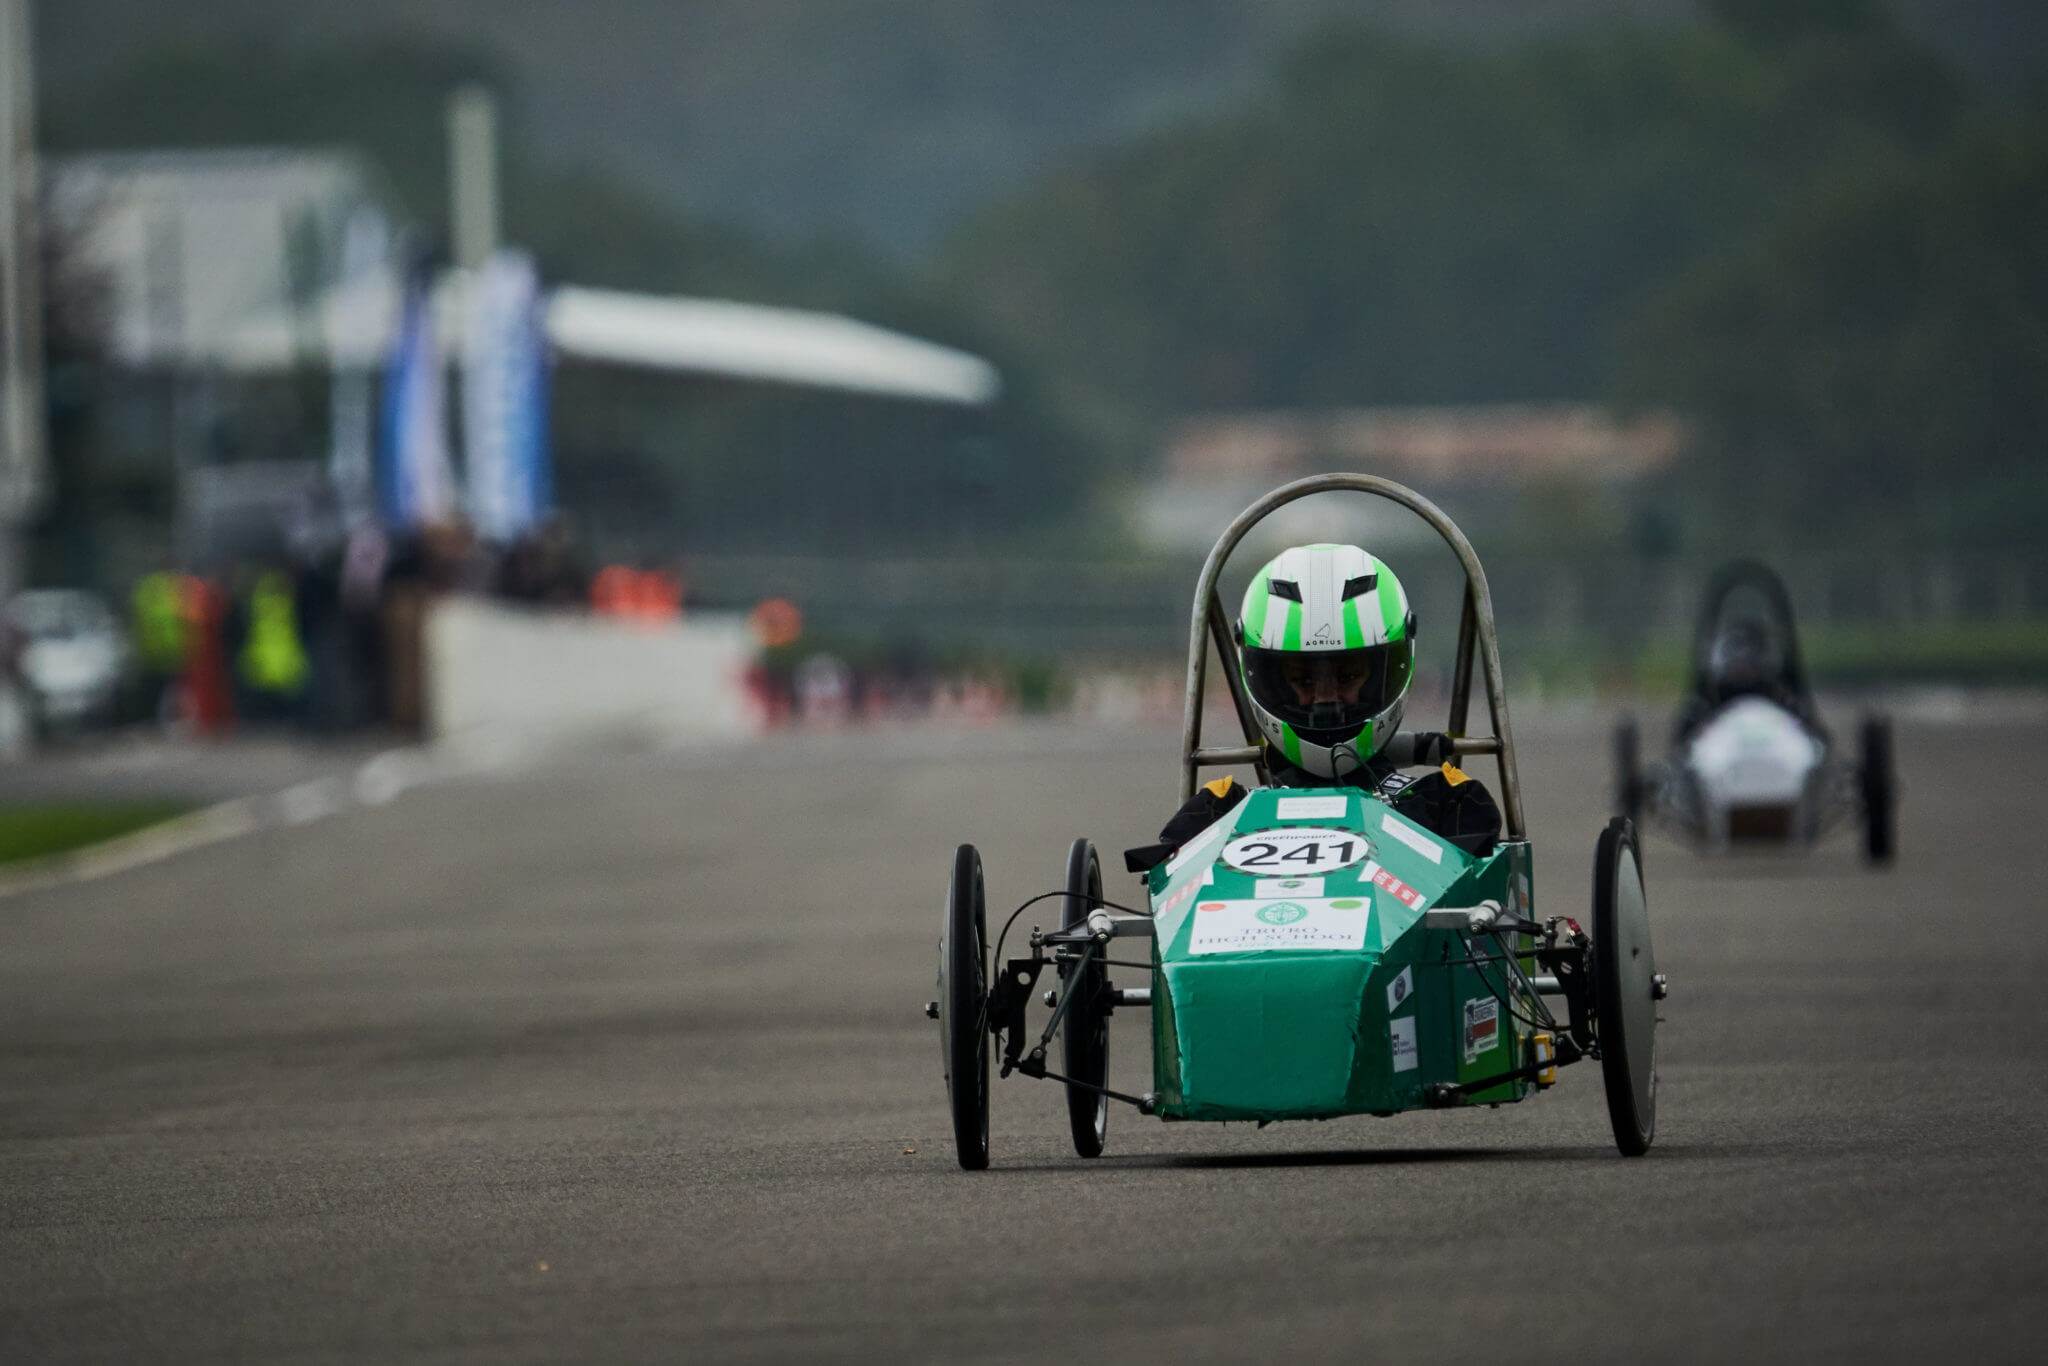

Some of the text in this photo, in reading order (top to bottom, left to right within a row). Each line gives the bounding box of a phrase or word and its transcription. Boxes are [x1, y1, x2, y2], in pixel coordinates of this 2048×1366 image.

[1240, 841, 1354, 866] 241
[1241, 927, 1319, 935] TRURO
[1198, 936, 1257, 944] HIGH
